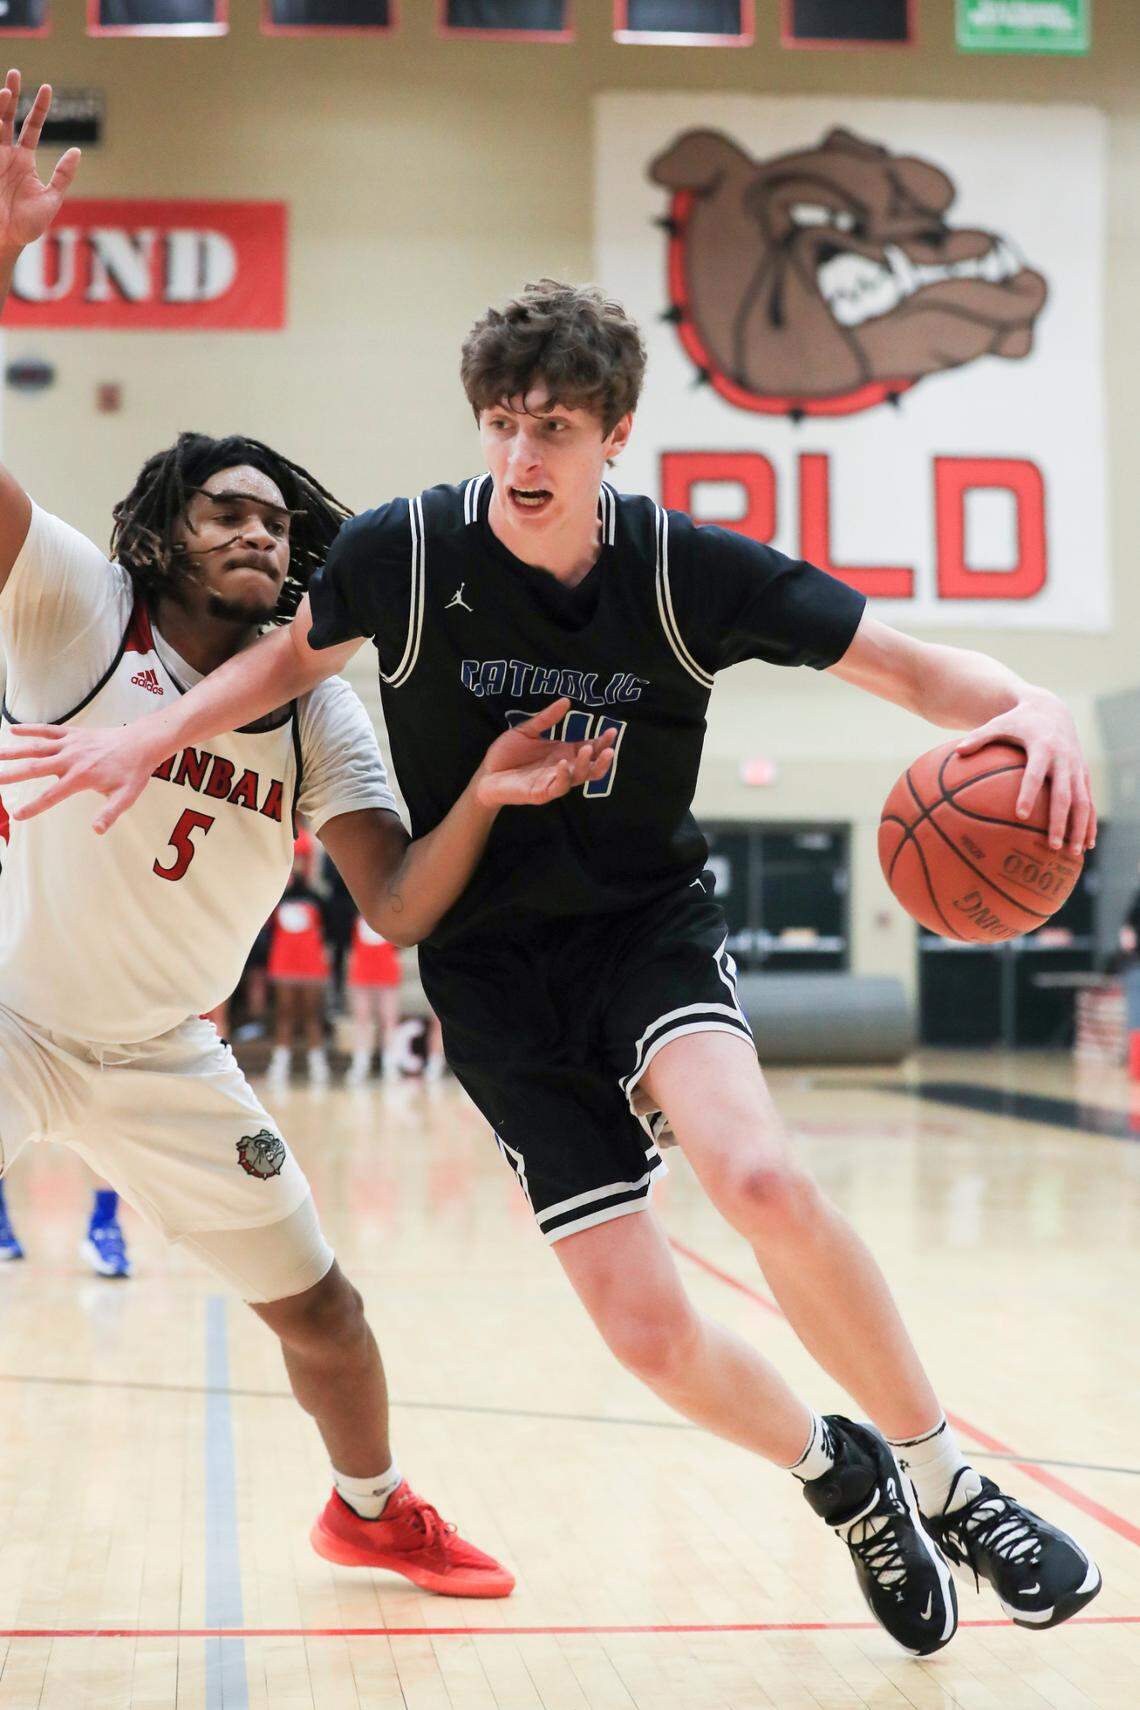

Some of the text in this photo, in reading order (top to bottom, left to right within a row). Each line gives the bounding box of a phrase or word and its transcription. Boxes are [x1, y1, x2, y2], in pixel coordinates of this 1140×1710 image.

[659, 450, 1048, 600] PLD
[131, 675, 164, 695] adidas
[460, 659, 650, 707] CATHOLIC
[152, 807, 216, 882] 5
[952, 890, 1018, 938] DING
